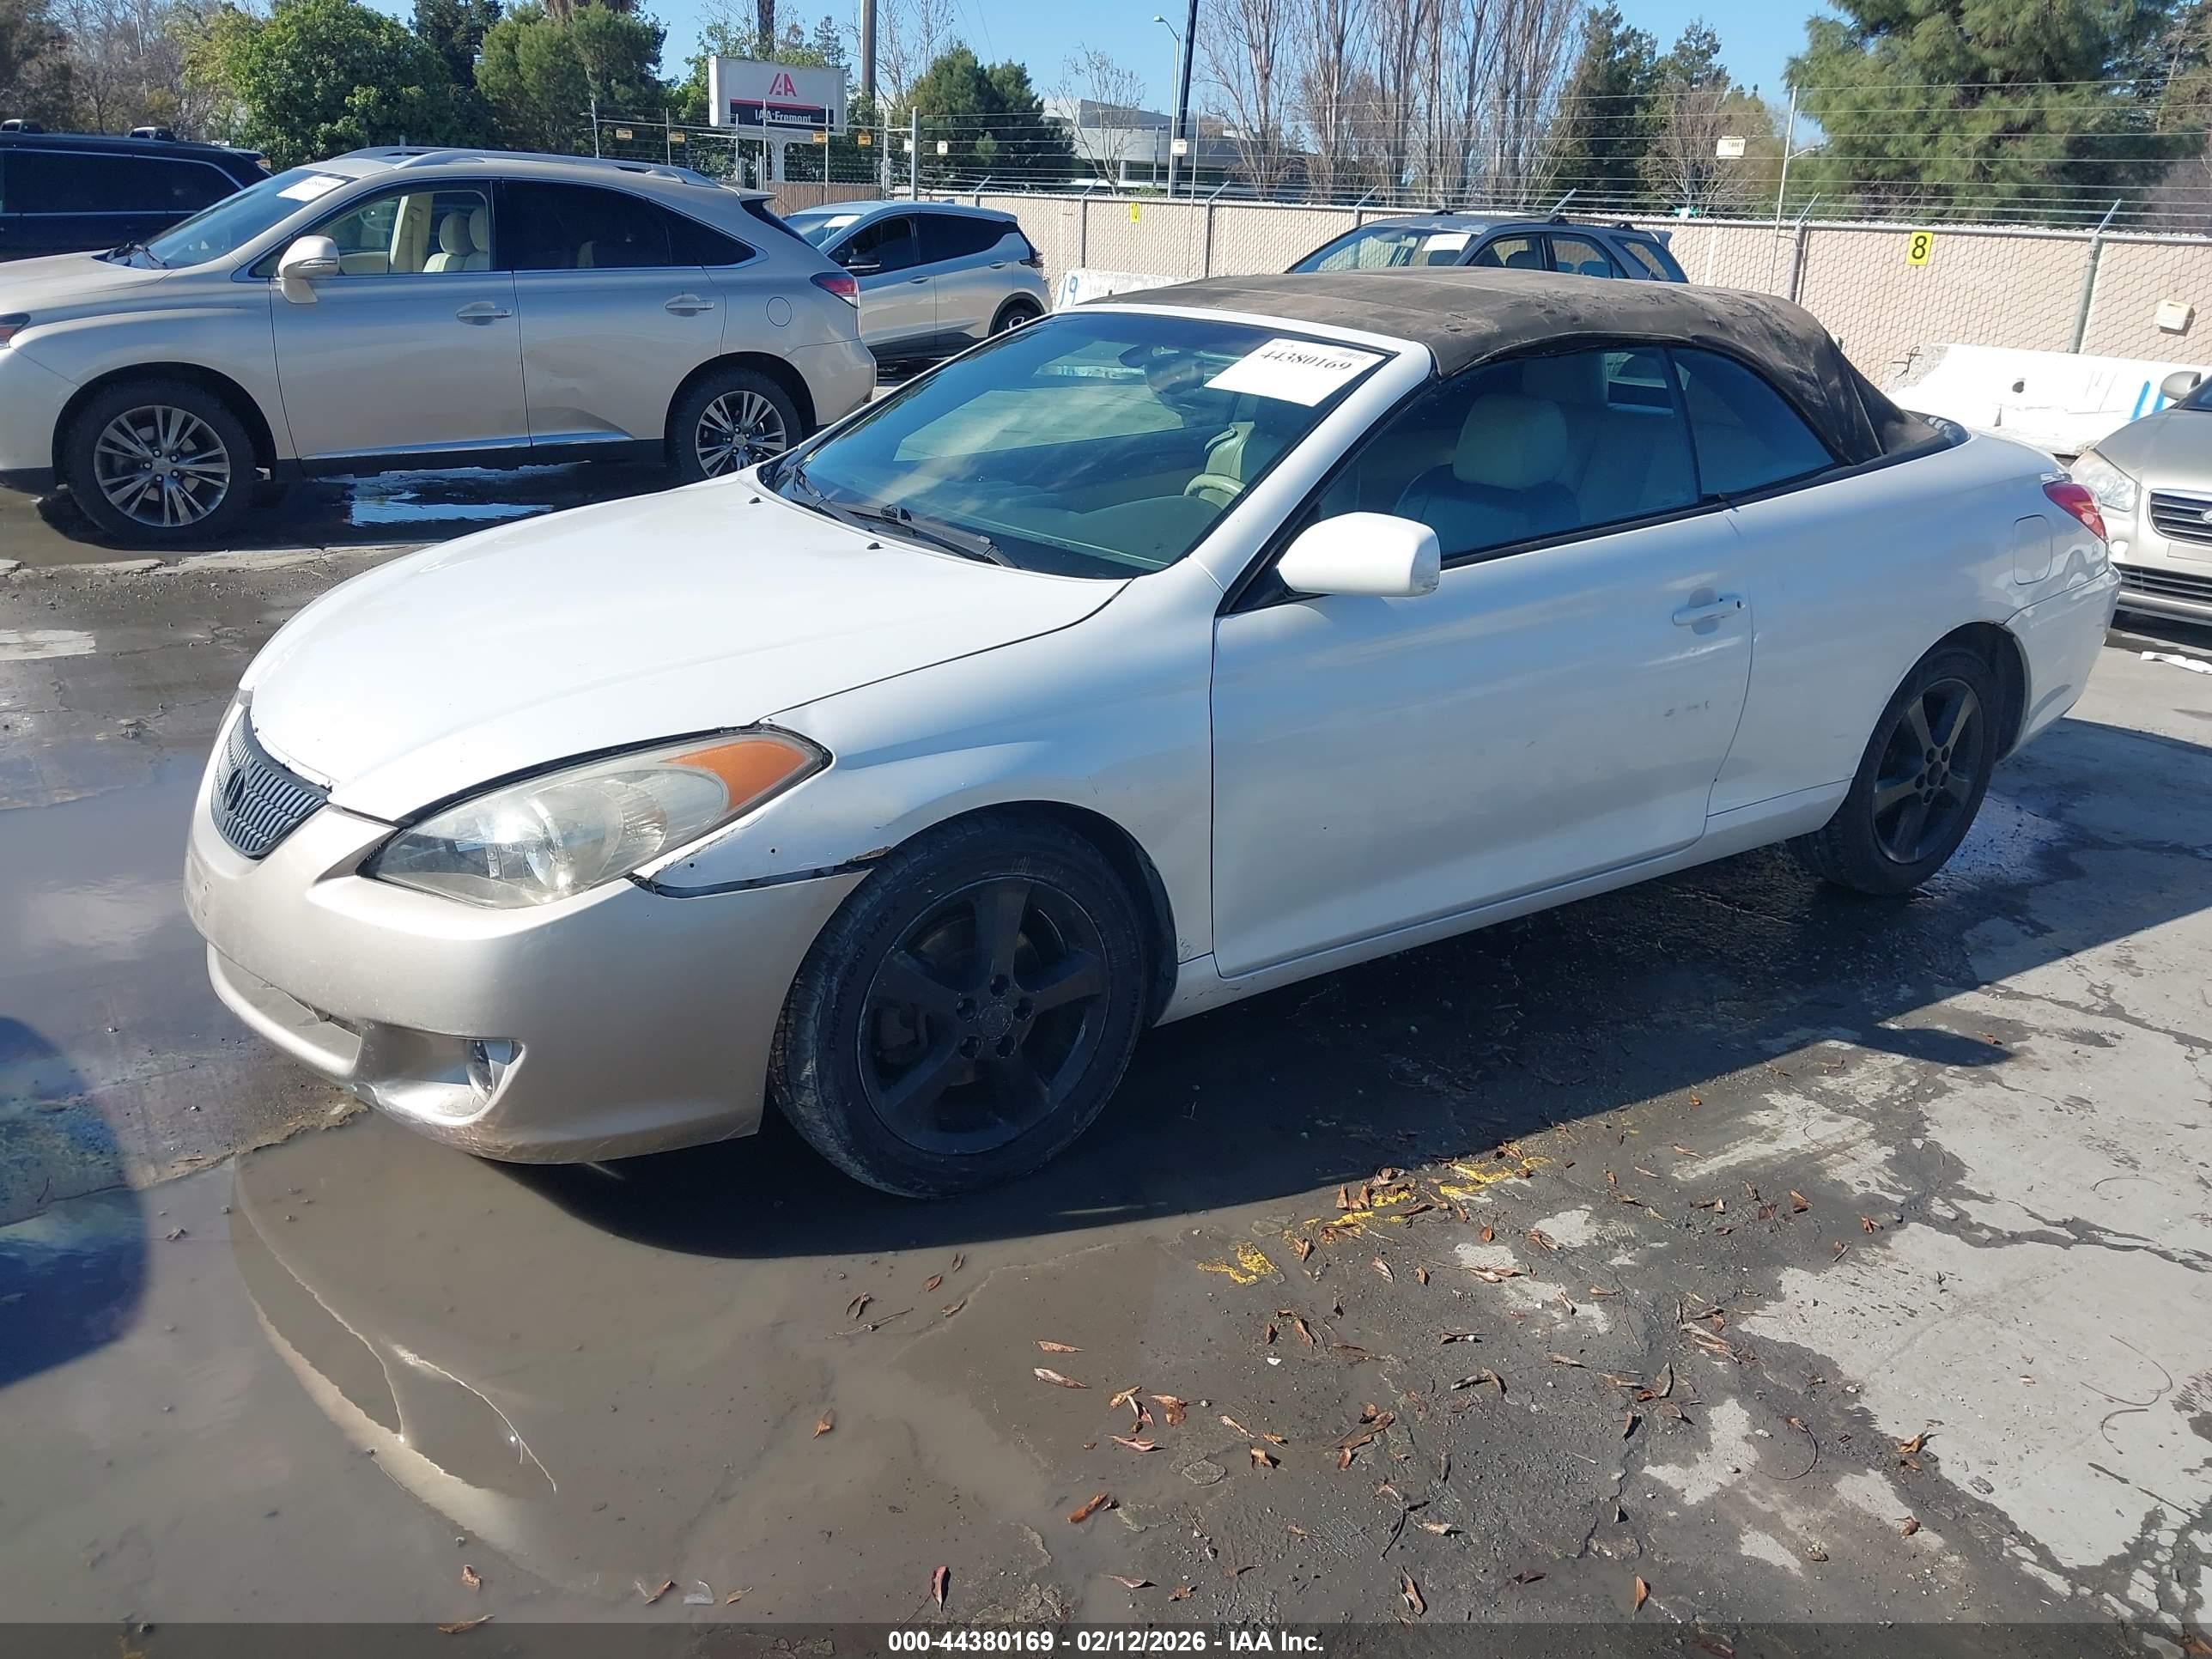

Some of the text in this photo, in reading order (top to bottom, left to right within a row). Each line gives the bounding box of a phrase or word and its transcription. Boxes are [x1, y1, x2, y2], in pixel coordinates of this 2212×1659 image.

[775, 111, 811, 124] Fremont
[1911, 235, 1927, 259] 8
[1260, 350, 1353, 371] 44380169
